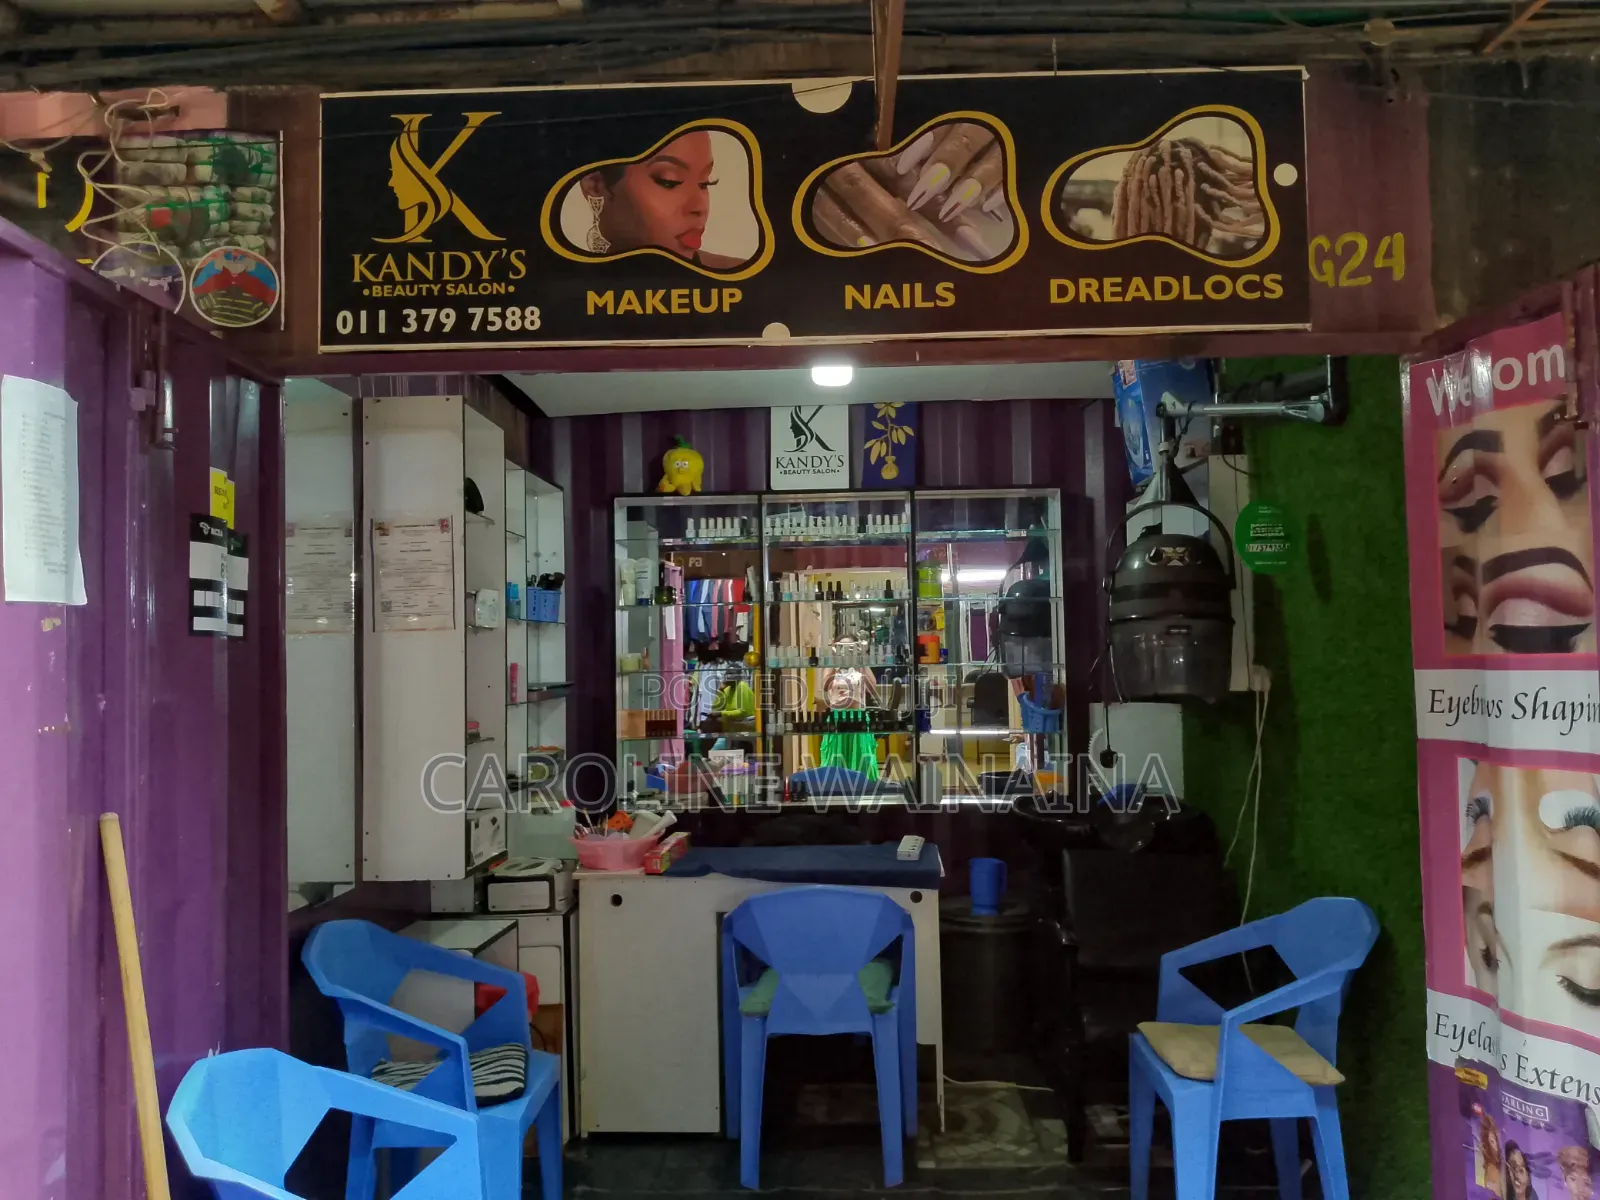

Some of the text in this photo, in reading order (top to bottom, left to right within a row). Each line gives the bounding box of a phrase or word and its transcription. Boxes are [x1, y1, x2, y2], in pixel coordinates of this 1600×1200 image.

[352, 248, 527, 284] KANDY'S
[1308, 231, 1405, 288] G24
[371, 281, 506, 298] BEAUTY SALON
[585, 286, 743, 317] MAKEUP
[844, 280, 957, 311] NAILS
[1049, 272, 1284, 305] DREADLOCS
[336, 305, 542, 336] 011 379 7588
[775, 454, 845, 469] KANDY'S
